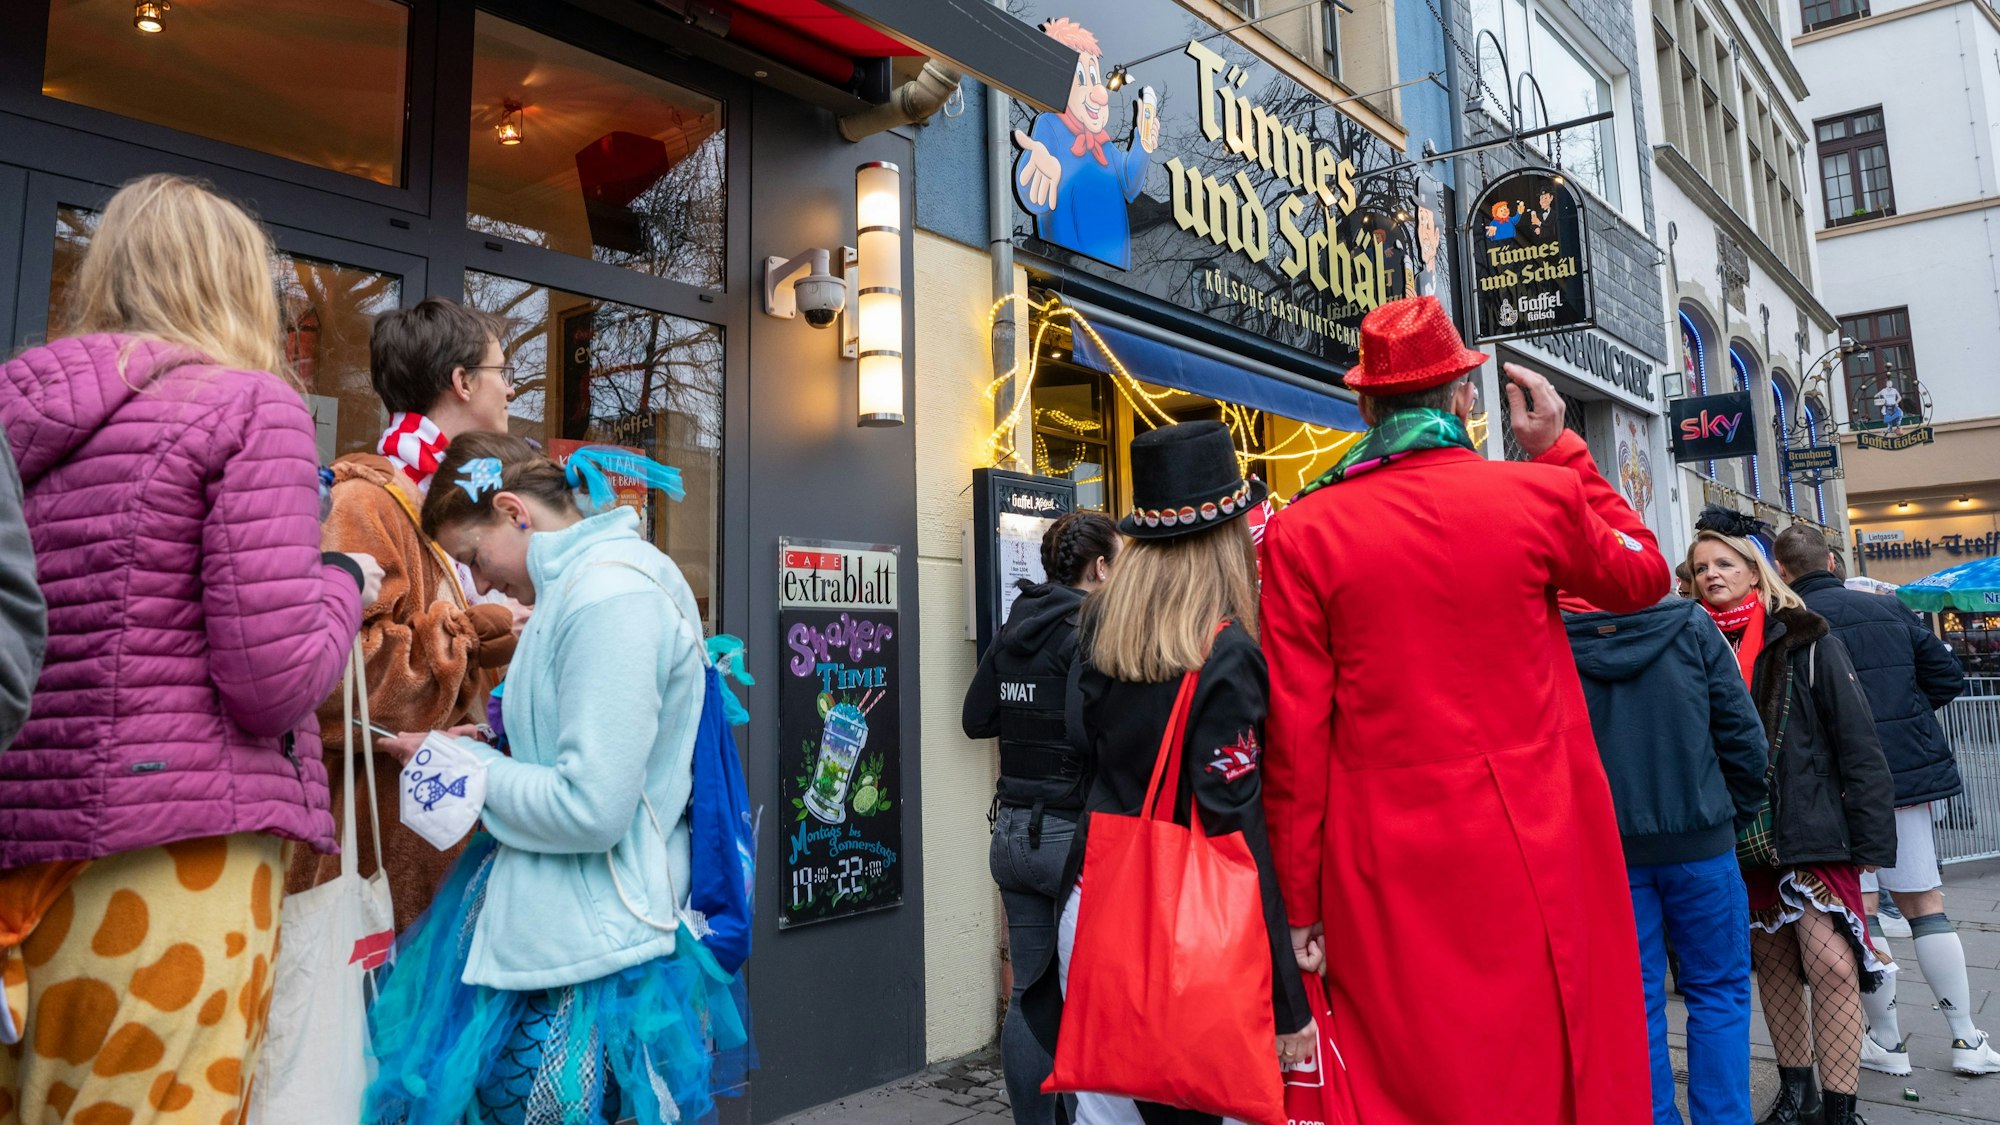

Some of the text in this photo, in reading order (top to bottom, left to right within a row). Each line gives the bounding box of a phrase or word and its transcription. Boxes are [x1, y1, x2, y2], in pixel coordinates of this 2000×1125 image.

[1185, 39, 1357, 216] Tünnes
[1165, 156, 1387, 310] und Schäl
[1487, 240, 1560, 268] Tünnes
[1479, 256, 1578, 292] und Schäl
[1204, 268, 1266, 313] KÖLSCHE
[1270, 294, 1361, 350] GASTWIRTSCHA
[1518, 290, 1563, 314] Gaffel
[1527, 309, 1556, 322] Kölsch
[1680, 409, 1743, 444] sky
[1861, 433, 1892, 450] Gaffel
[1788, 449, 1832, 461] Brauhaus
[1011, 494, 1034, 509] Gaffel
[1868, 532, 1899, 541] Lintgasse
[784, 555, 896, 605] extrablatt
[787, 612, 894, 677] Shaker
[1000, 681, 1036, 702] SWAT
[789, 820, 842, 865] Montags
